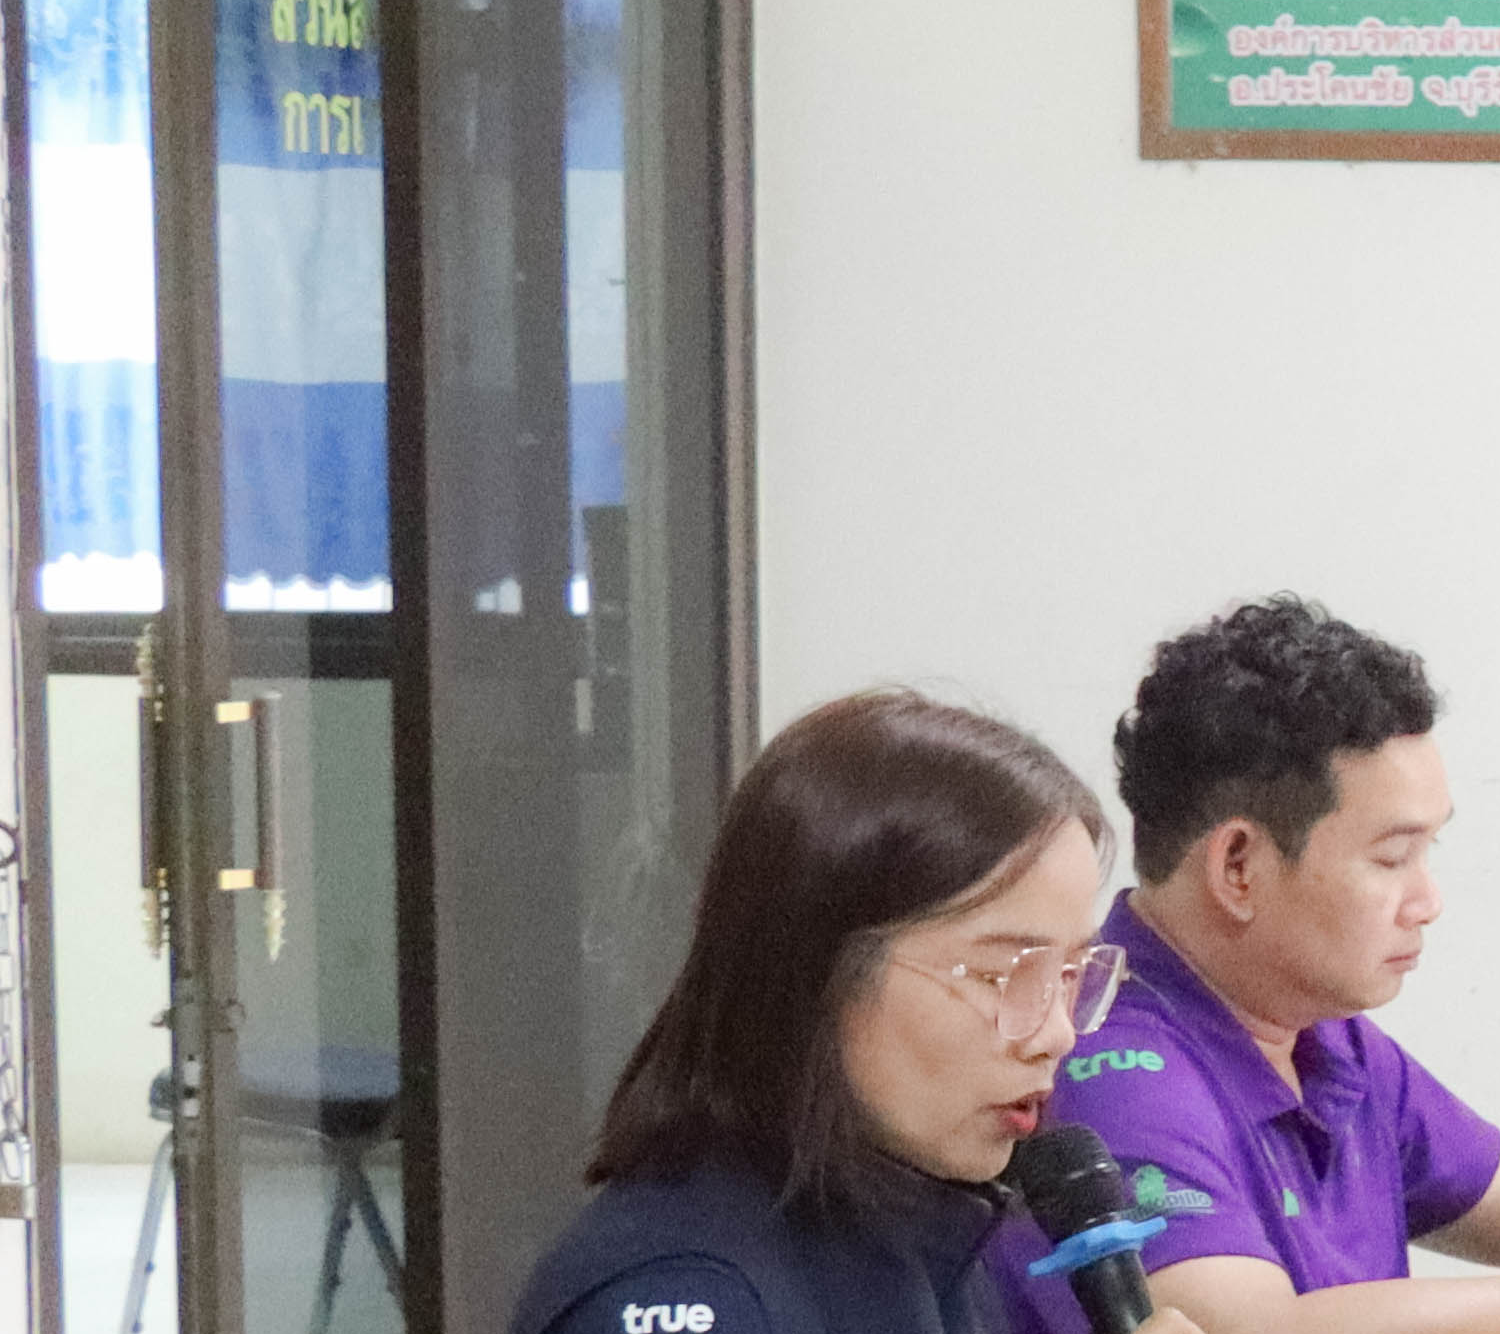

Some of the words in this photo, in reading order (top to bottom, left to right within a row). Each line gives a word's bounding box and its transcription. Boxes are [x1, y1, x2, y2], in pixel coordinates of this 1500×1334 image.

[1230, 61, 1413, 107] อ.ประโคนชัย
[1065, 1048, 1166, 1083] true
